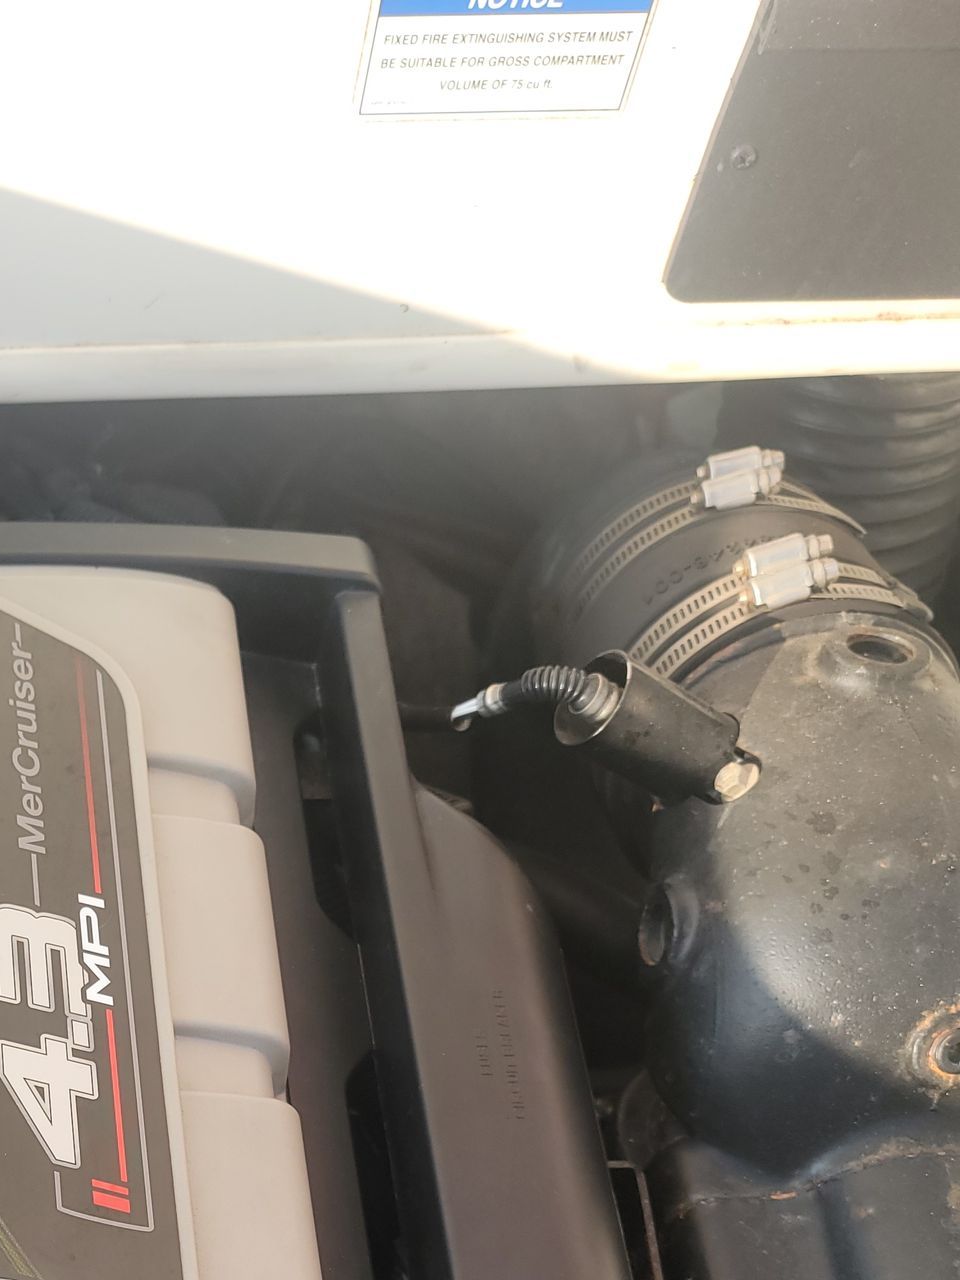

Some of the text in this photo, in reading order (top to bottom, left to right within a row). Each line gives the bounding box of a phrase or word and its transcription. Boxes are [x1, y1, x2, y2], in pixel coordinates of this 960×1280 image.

[384, 31, 633, 45] FIXED FIRE EXTINGUISHING SYSTEM MUST
[381, 55, 625, 69] BE SUITABLE FOR GROSS COMPARTMENT
[440, 80, 487, 91] VOLUME
[491, 80, 508, 90] OF
[511, 79, 523, 89] 75
[526, 81, 540, 89] cu
[9, 642, 46, 854] MerCruiser
[77, 893, 115, 1006] MPI
